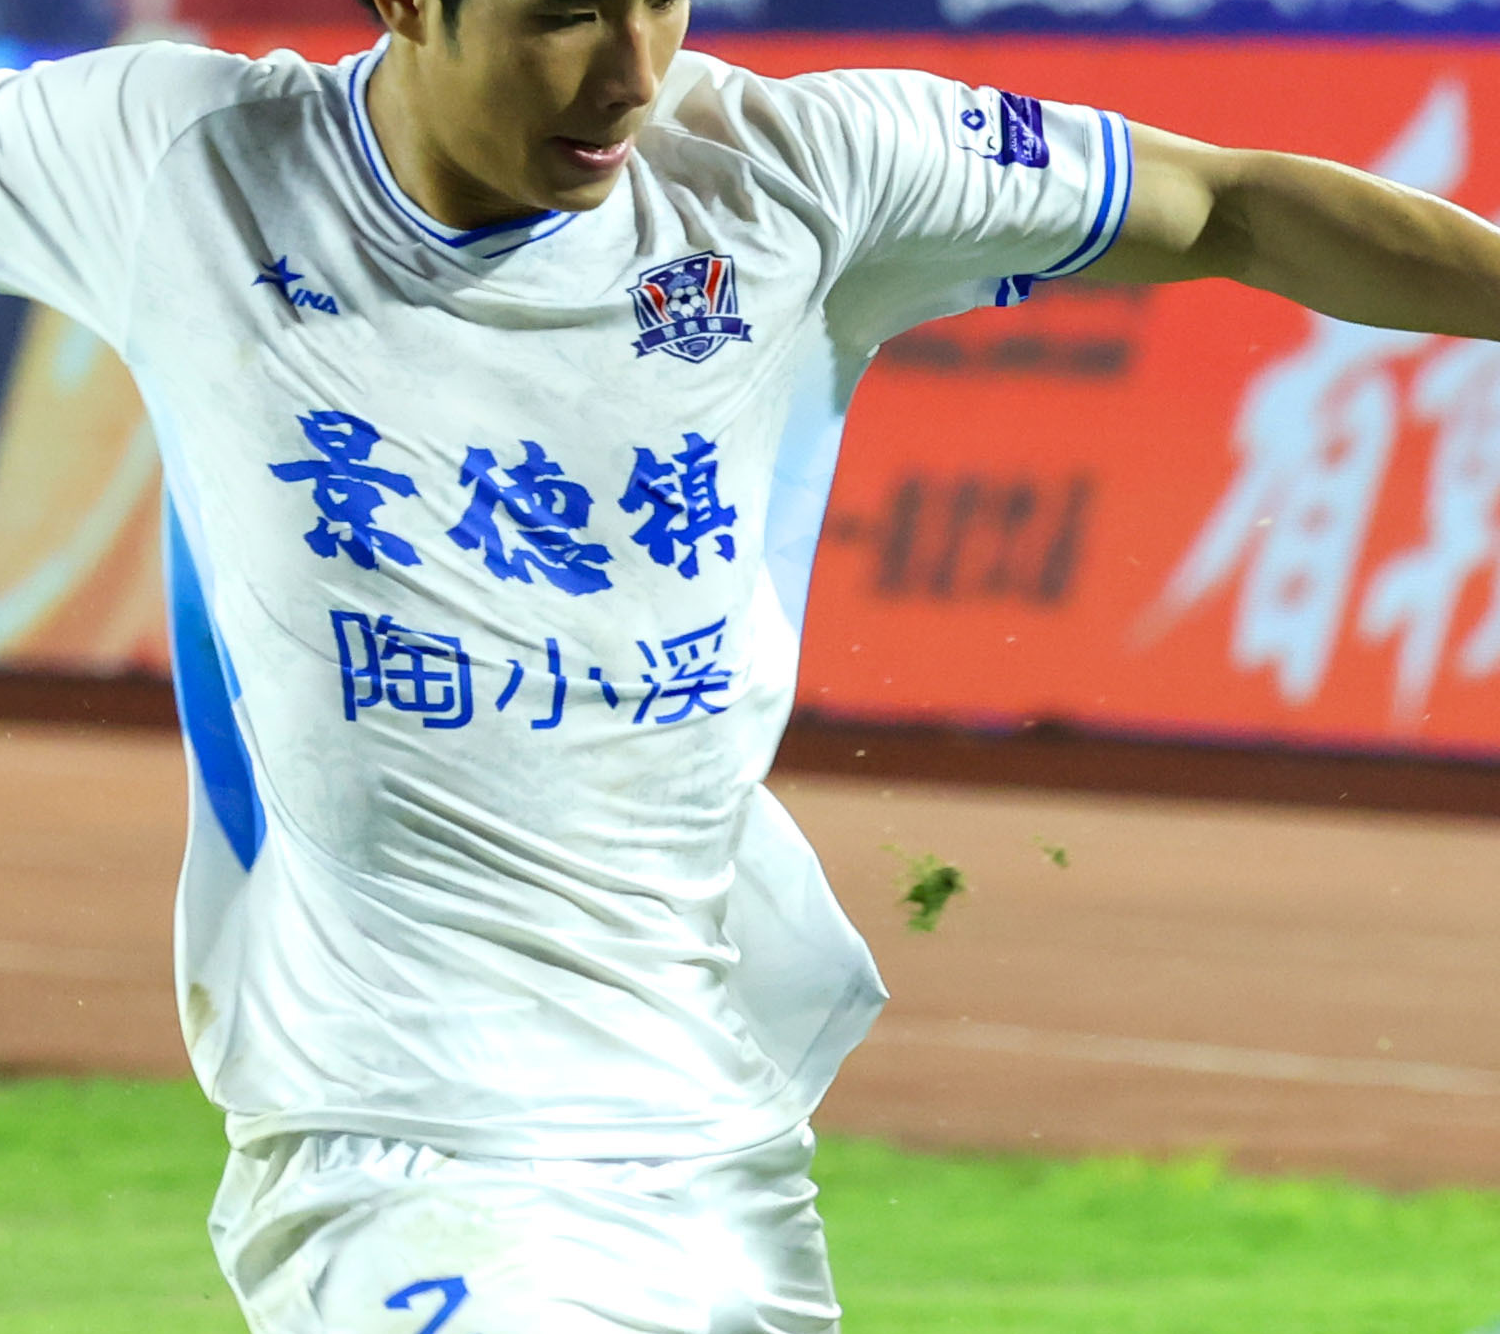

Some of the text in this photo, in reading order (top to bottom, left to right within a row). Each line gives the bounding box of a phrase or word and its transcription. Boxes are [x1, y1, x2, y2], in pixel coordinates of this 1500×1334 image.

[267, 409, 738, 597] 景德镇
[328, 609, 736, 731] 陶小溪
